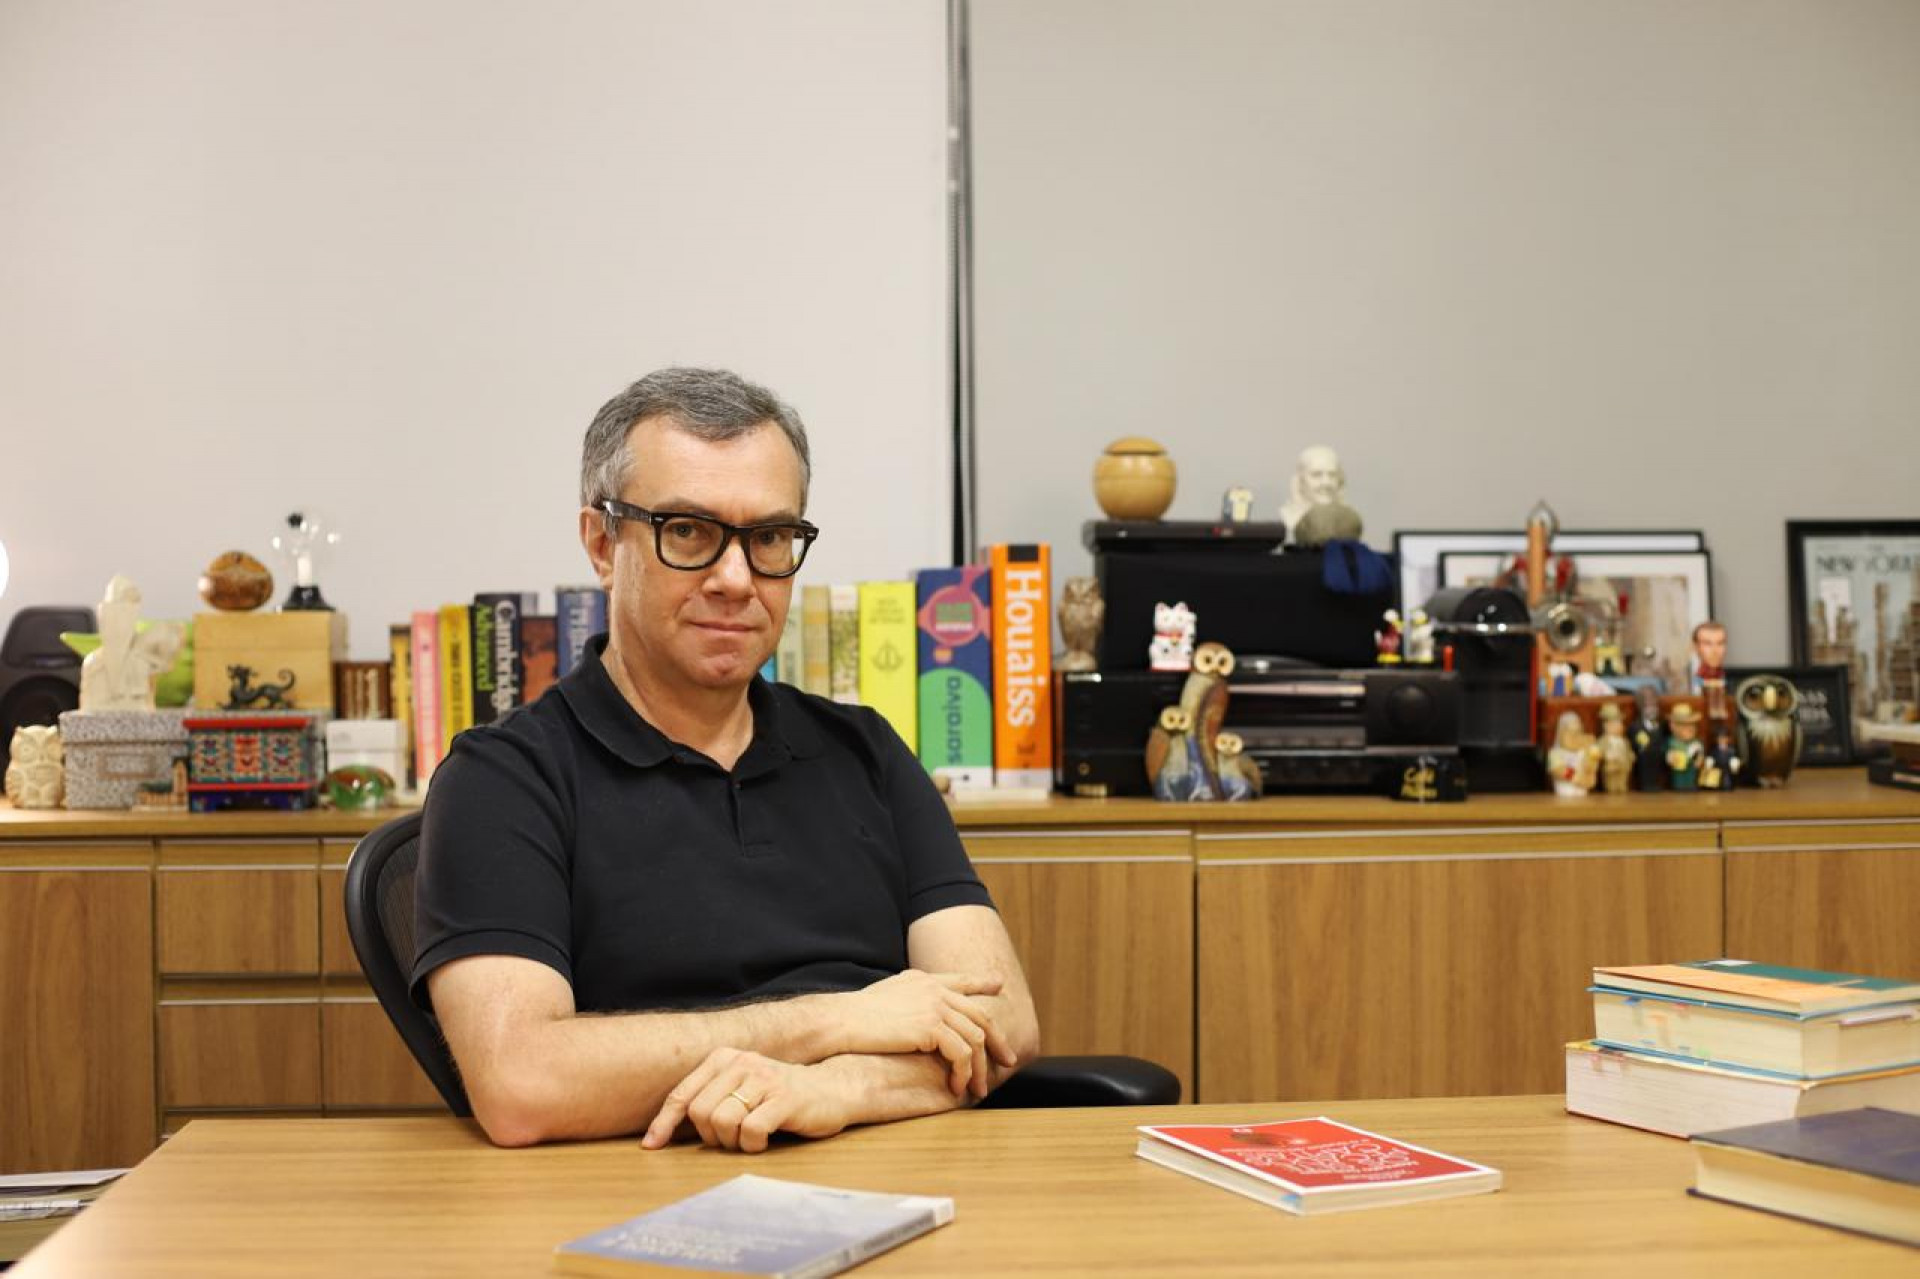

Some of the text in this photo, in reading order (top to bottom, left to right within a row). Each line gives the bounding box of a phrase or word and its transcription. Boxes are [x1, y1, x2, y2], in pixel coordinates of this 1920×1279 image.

[1816, 554, 1855, 572] NEW
[476, 604, 495, 691] Advanced
[1004, 569, 1047, 727] Houaiss
[942, 676, 962, 763] saraiva
